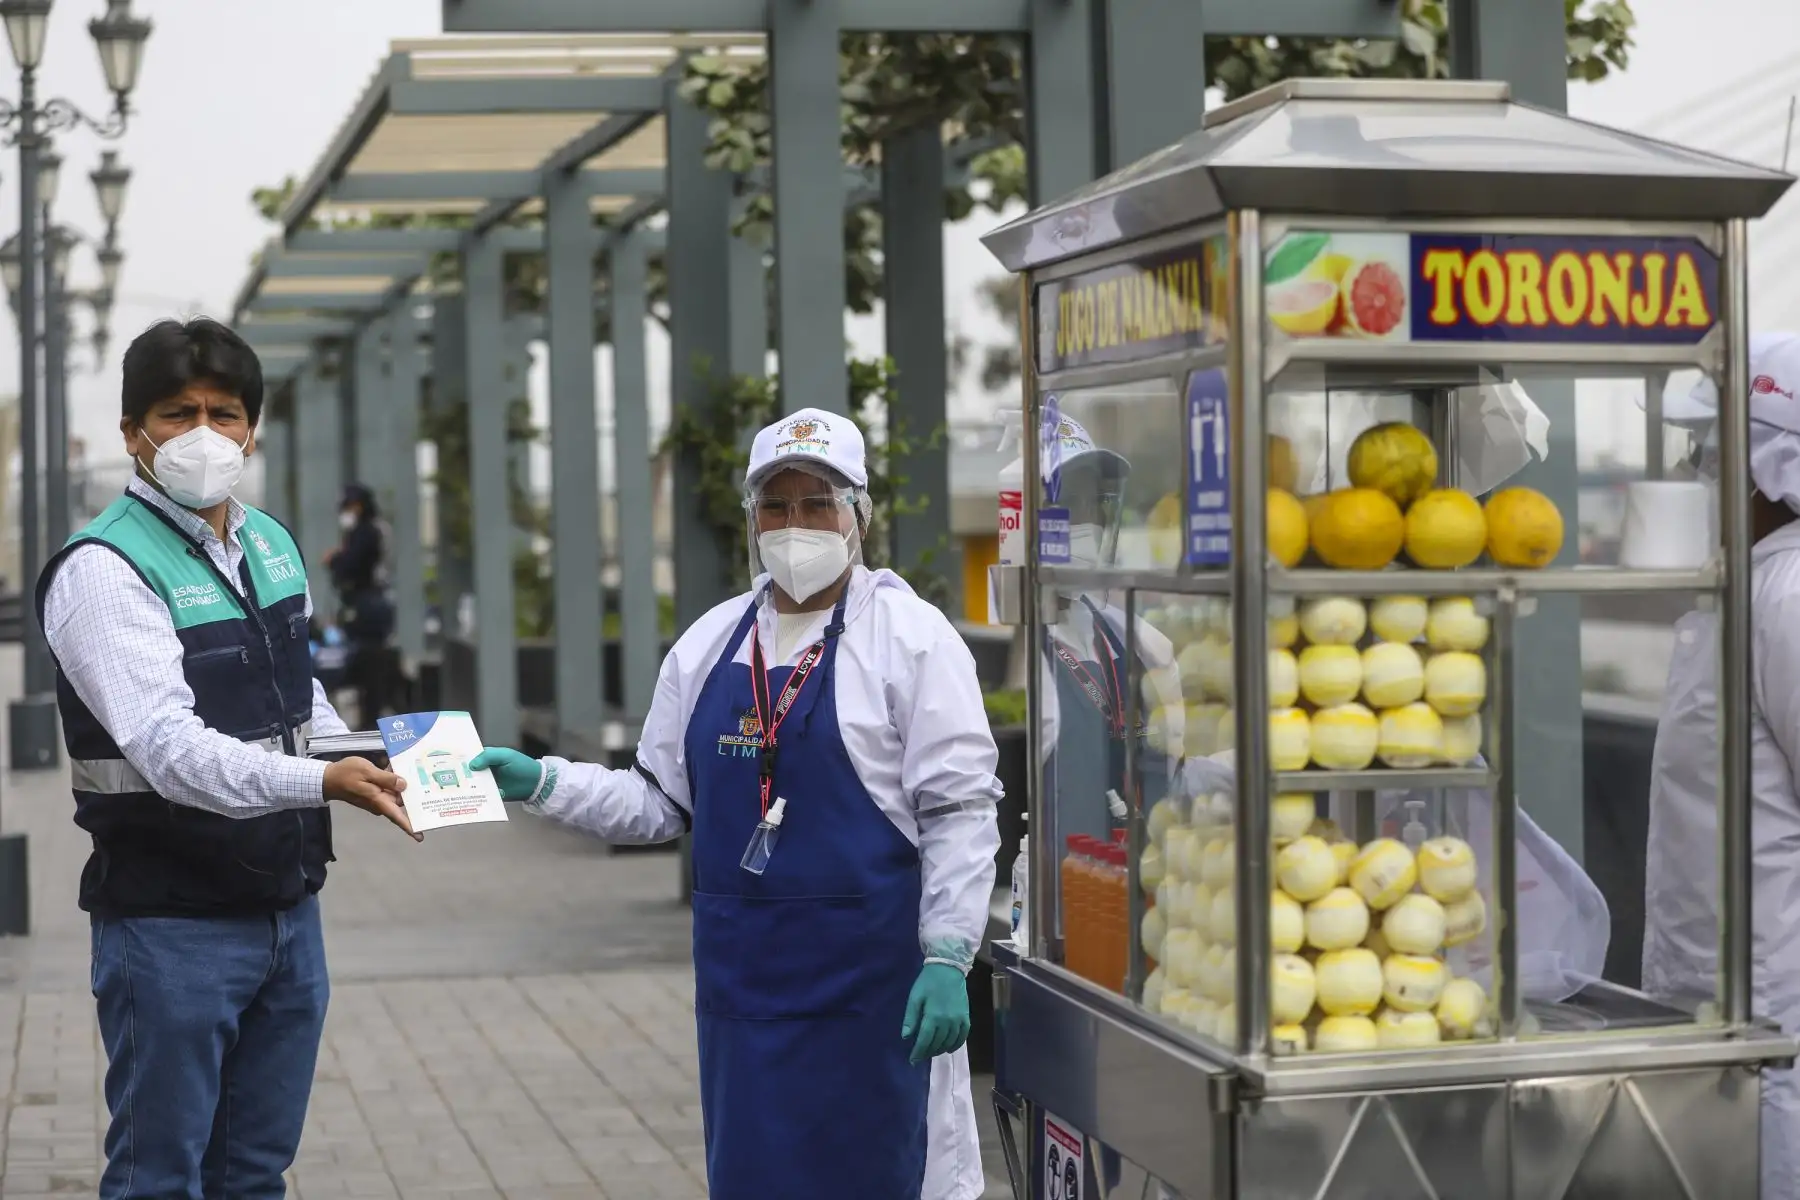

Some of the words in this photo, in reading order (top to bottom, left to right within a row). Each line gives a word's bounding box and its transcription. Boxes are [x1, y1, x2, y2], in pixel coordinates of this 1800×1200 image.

[1420, 247, 1712, 328] TORONJA
[1057, 287, 1095, 357] JUGO
[1098, 278, 1119, 348] DE
[1120, 258, 1202, 343] NARANJA
[266, 562, 300, 583] LIMA
[389, 732, 417, 743] LIMA
[719, 734, 764, 744] MUNICIPALIDA
[718, 743, 757, 758] LIM
